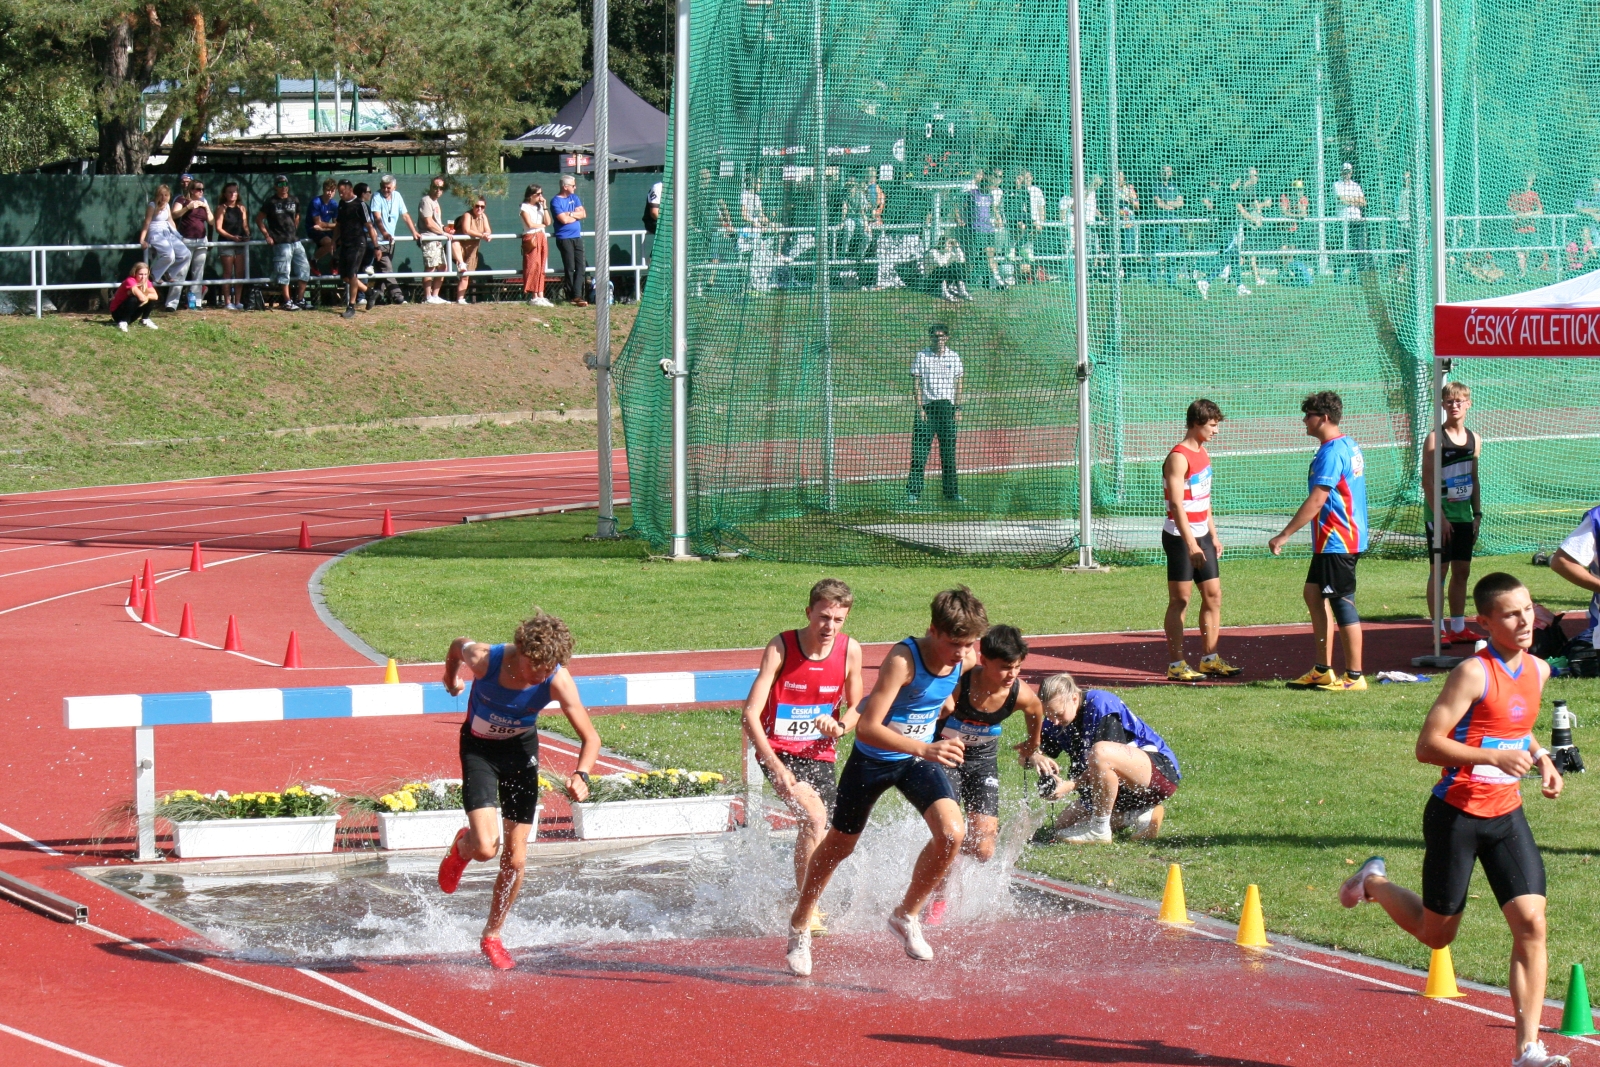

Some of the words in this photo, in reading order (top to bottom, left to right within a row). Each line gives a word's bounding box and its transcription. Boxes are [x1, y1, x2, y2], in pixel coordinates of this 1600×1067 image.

[1464, 308, 1519, 345] ČESKÝ
[1455, 485, 1468, 494] 258
[791, 706, 813, 715] ČESKÁ
[490, 713, 512, 725] ČESKÁ
[908, 712, 930, 720] ČESKÁ
[488, 725, 515, 734] 586
[787, 720, 816, 735] 497
[903, 724, 928, 735] 345
[960, 724, 982, 733] ČESKÁ
[1498, 741, 1518, 750] ČESKÁ
